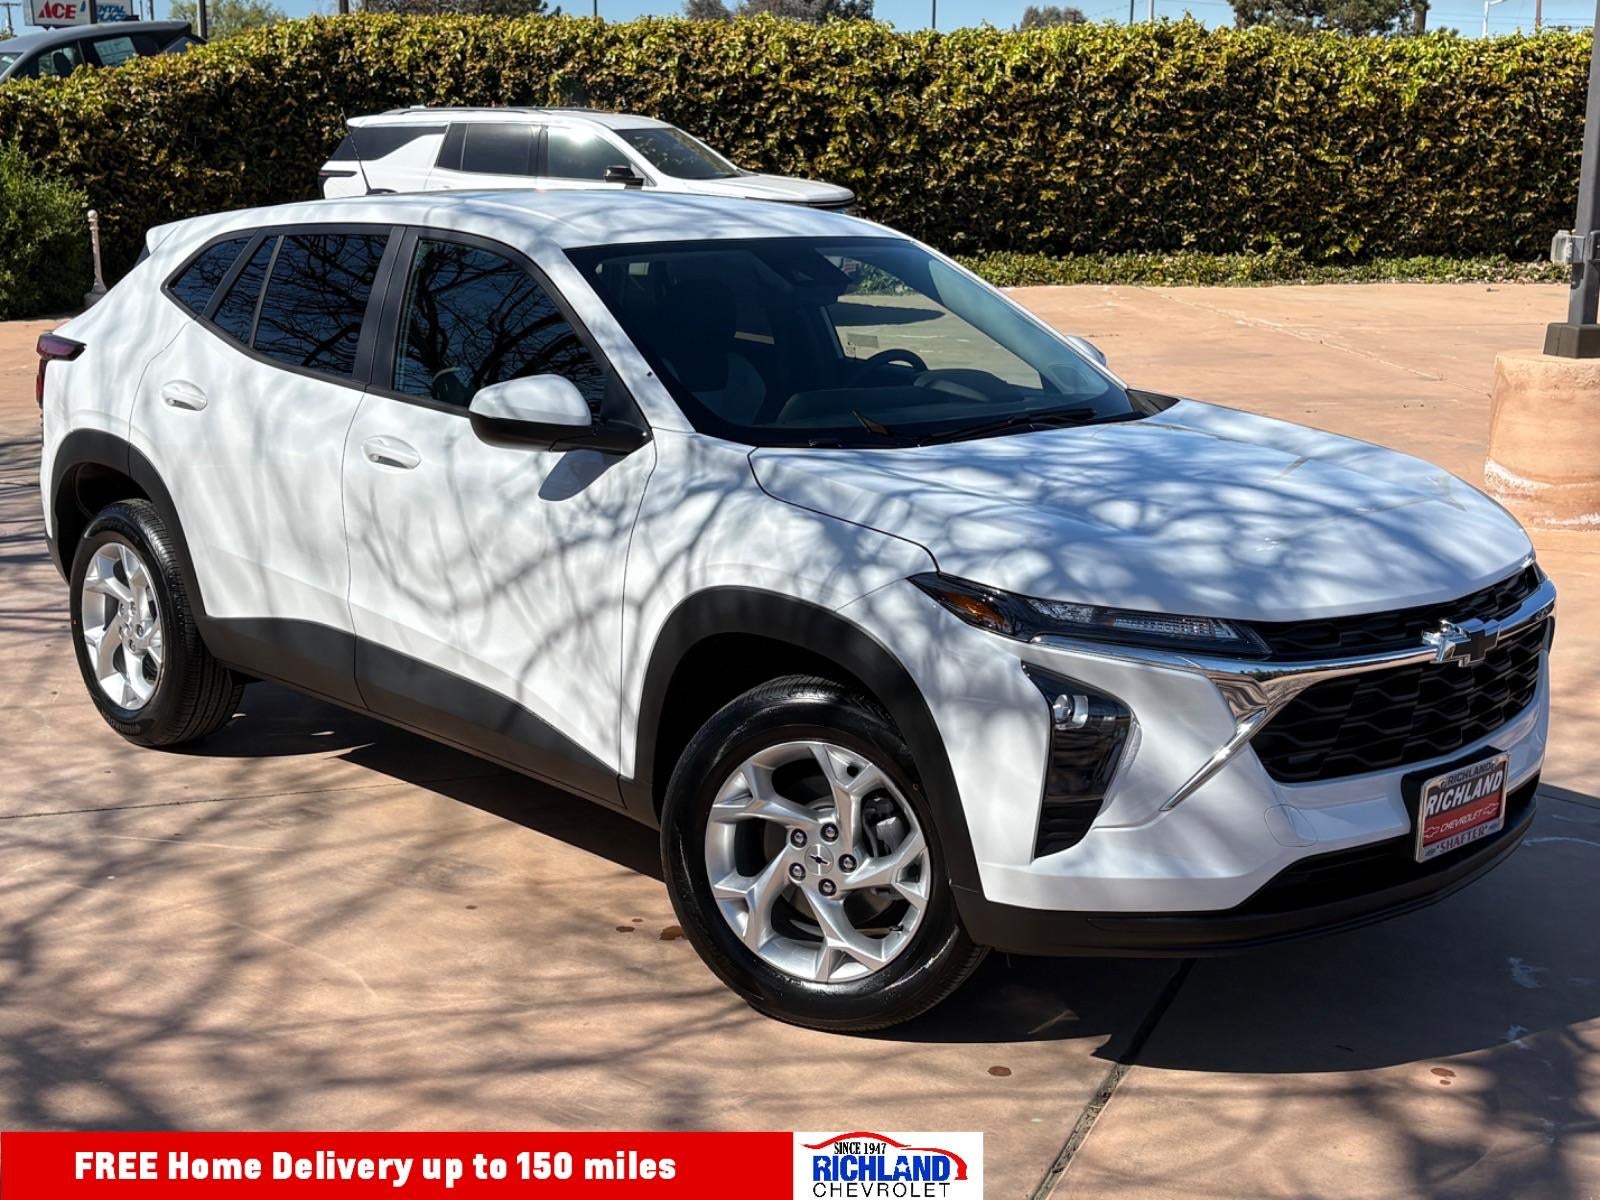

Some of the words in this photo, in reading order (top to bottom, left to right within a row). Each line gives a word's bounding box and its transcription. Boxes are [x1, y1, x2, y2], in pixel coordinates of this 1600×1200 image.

[38, 1, 77, 19] ACE
[1426, 770, 1504, 816] RICHLAND
[1440, 808, 1483, 832] CHEVROLET
